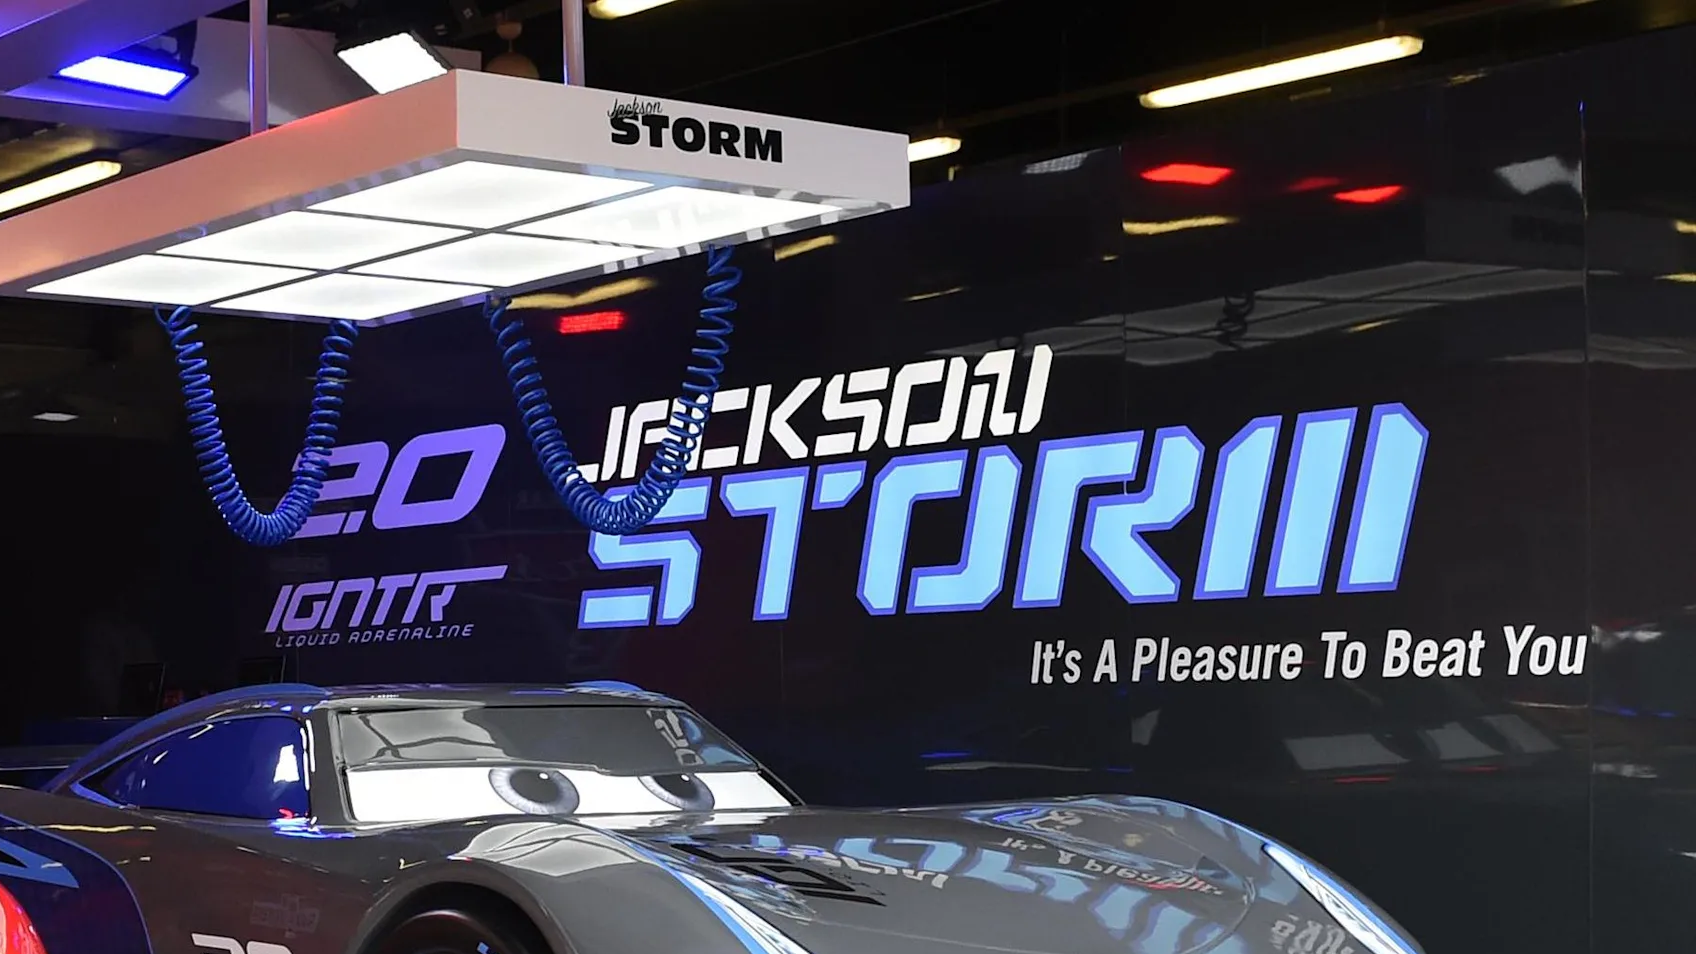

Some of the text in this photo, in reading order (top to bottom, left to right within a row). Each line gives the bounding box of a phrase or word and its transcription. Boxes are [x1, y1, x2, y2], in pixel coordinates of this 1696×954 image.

[607, 96, 662, 119] Jackson
[610, 113, 783, 164] STORM
[566, 344, 1052, 483] JACKSON
[578, 402, 1430, 629] STORM
[265, 565, 508, 633] IGNTR
[275, 624, 474, 649] LIQUID ADRENALINE
[1030, 624, 1588, 684] It's A Pleasure To Beat You
